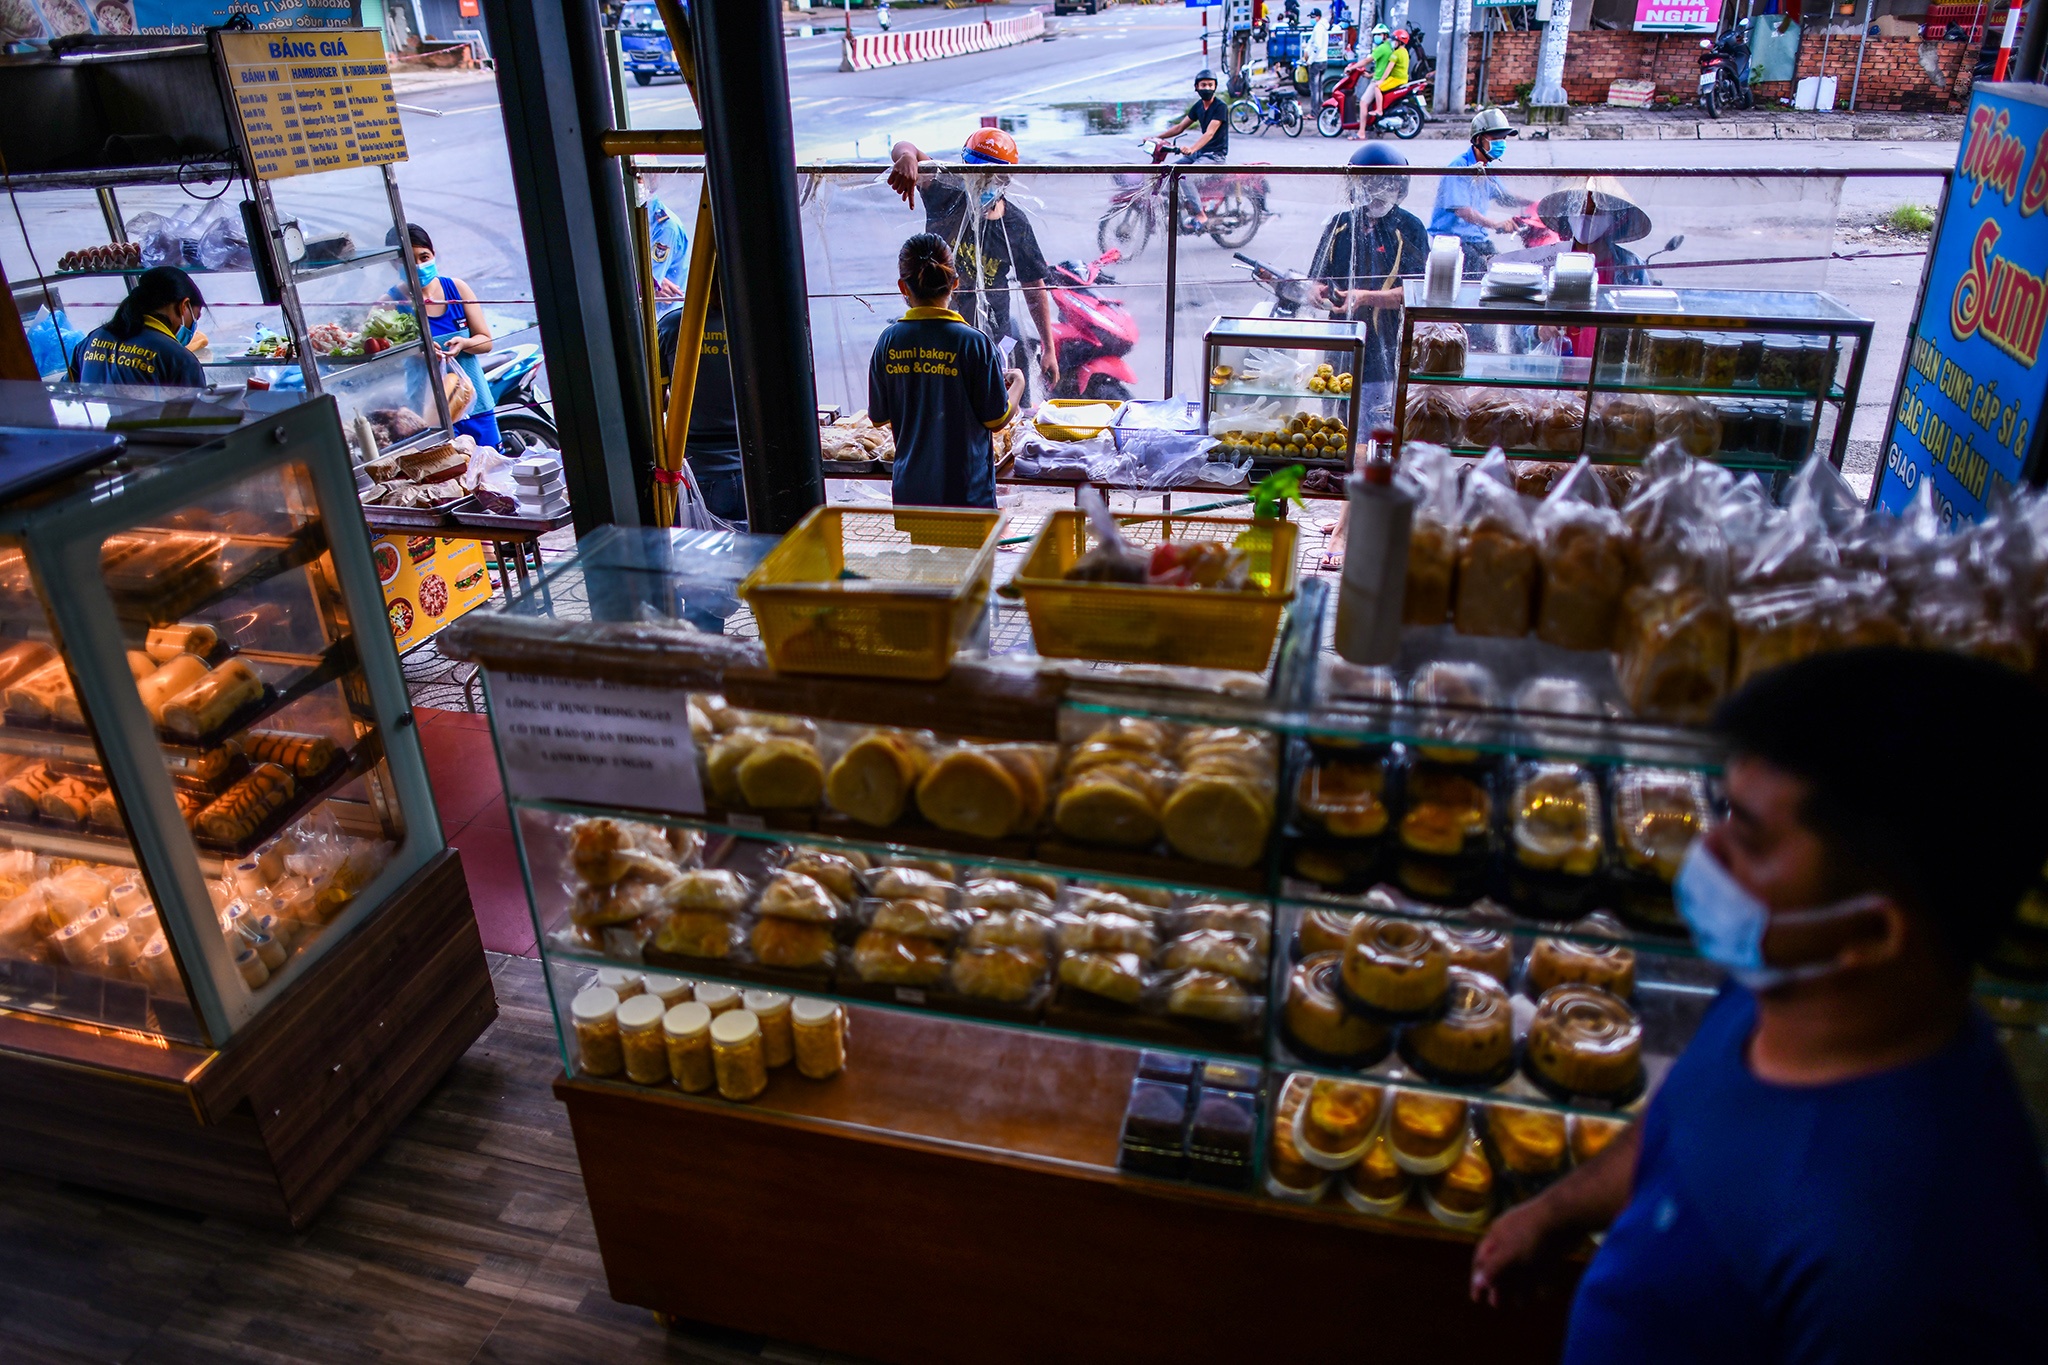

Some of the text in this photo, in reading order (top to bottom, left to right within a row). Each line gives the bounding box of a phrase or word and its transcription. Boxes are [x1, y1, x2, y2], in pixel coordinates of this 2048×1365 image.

[1645, 7, 1709, 22] NGHỈ
[268, 36, 348, 58] BẢNG GIÁ
[241, 67, 280, 83] BÁNH MÌ
[291, 66, 338, 79] HAMBURGER
[1961, 104, 2026, 207] Tiệm
[1951, 217, 2048, 370] Sumi
[703, 331, 728, 341] umi
[91, 338, 157, 361] Sumi bakery
[888, 347, 957, 364] Sumi bakery
[83, 350, 155, 374] Cake & Coffee
[885, 363, 910, 375] Cake
[1910, 335, 2030, 460] NHẬN CUNG CẤP SỈ &
[1898, 384, 1924, 436] CÁC
[1919, 406, 1952, 467] LOẠI
[1946, 433, 1990, 501] BÁNH
[1887, 442, 1917, 490] GIAO
